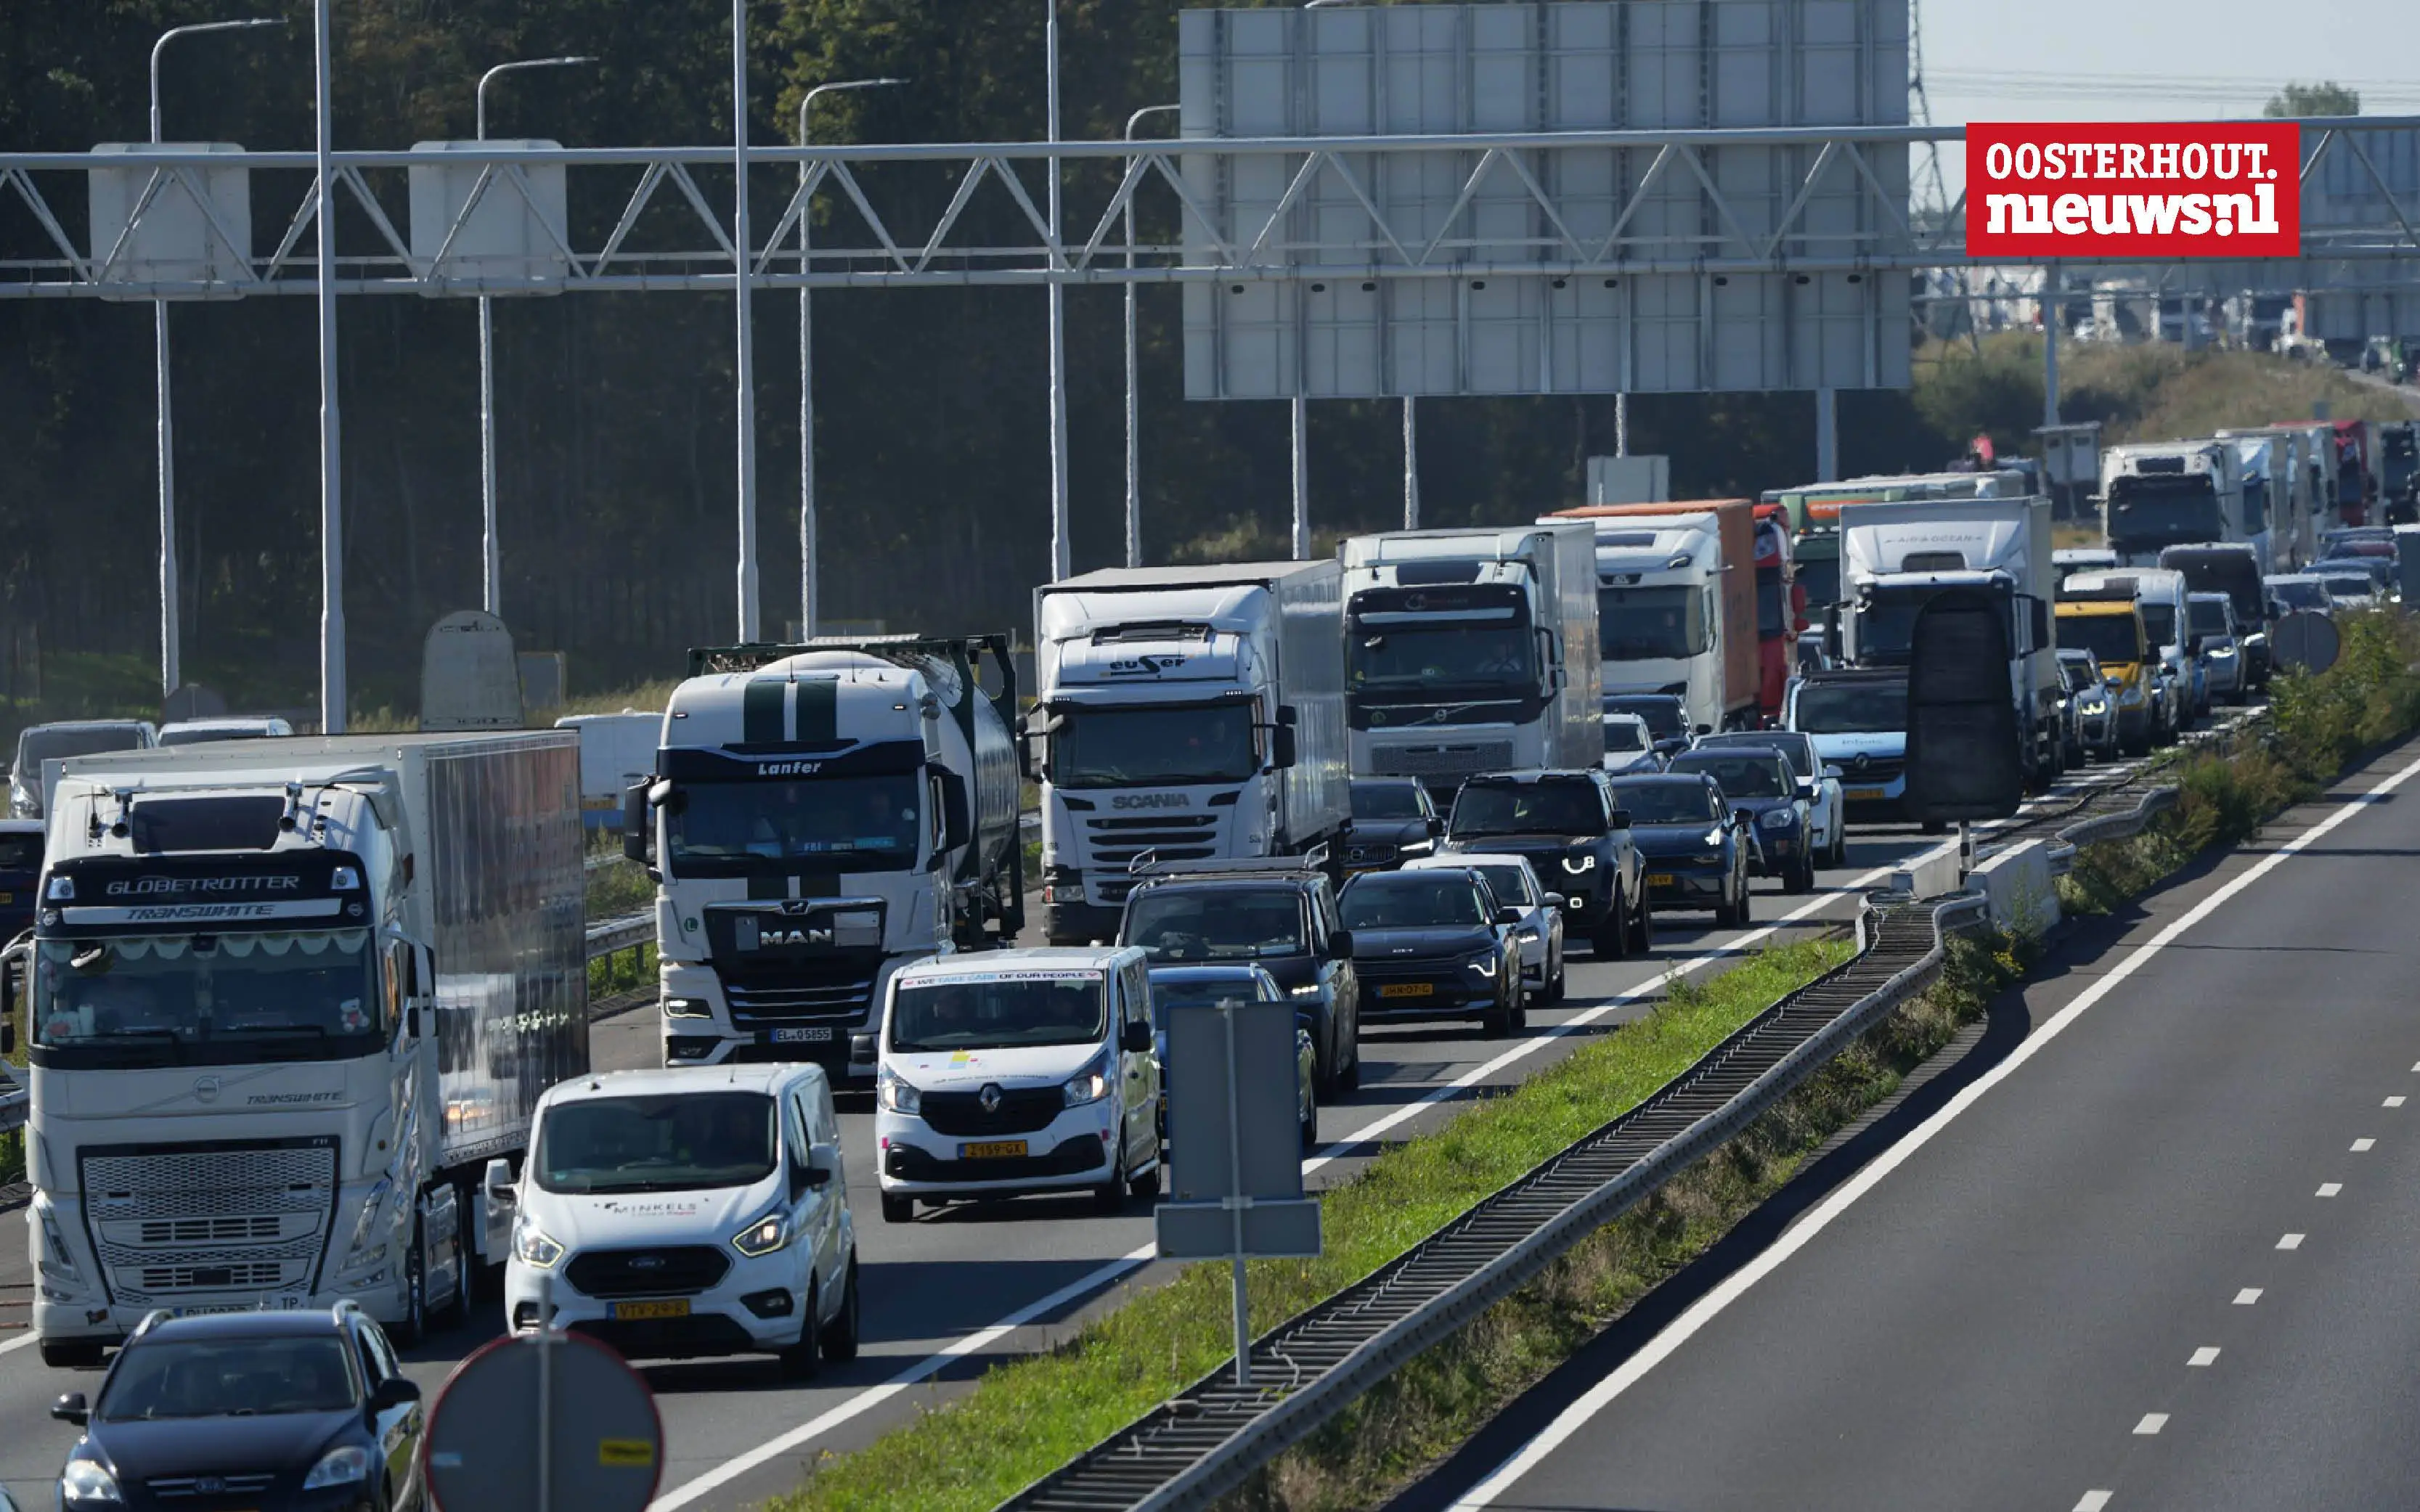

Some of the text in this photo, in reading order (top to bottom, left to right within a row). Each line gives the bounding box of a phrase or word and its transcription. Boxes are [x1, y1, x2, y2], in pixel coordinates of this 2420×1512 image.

[758, 761, 821, 776] Lanfer
[1112, 793, 1189, 809] SCANIA
[107, 875, 300, 895] GLOBETROTTER
[126, 904, 275, 920] TRANSWHITE
[761, 929, 831, 944] MAN
